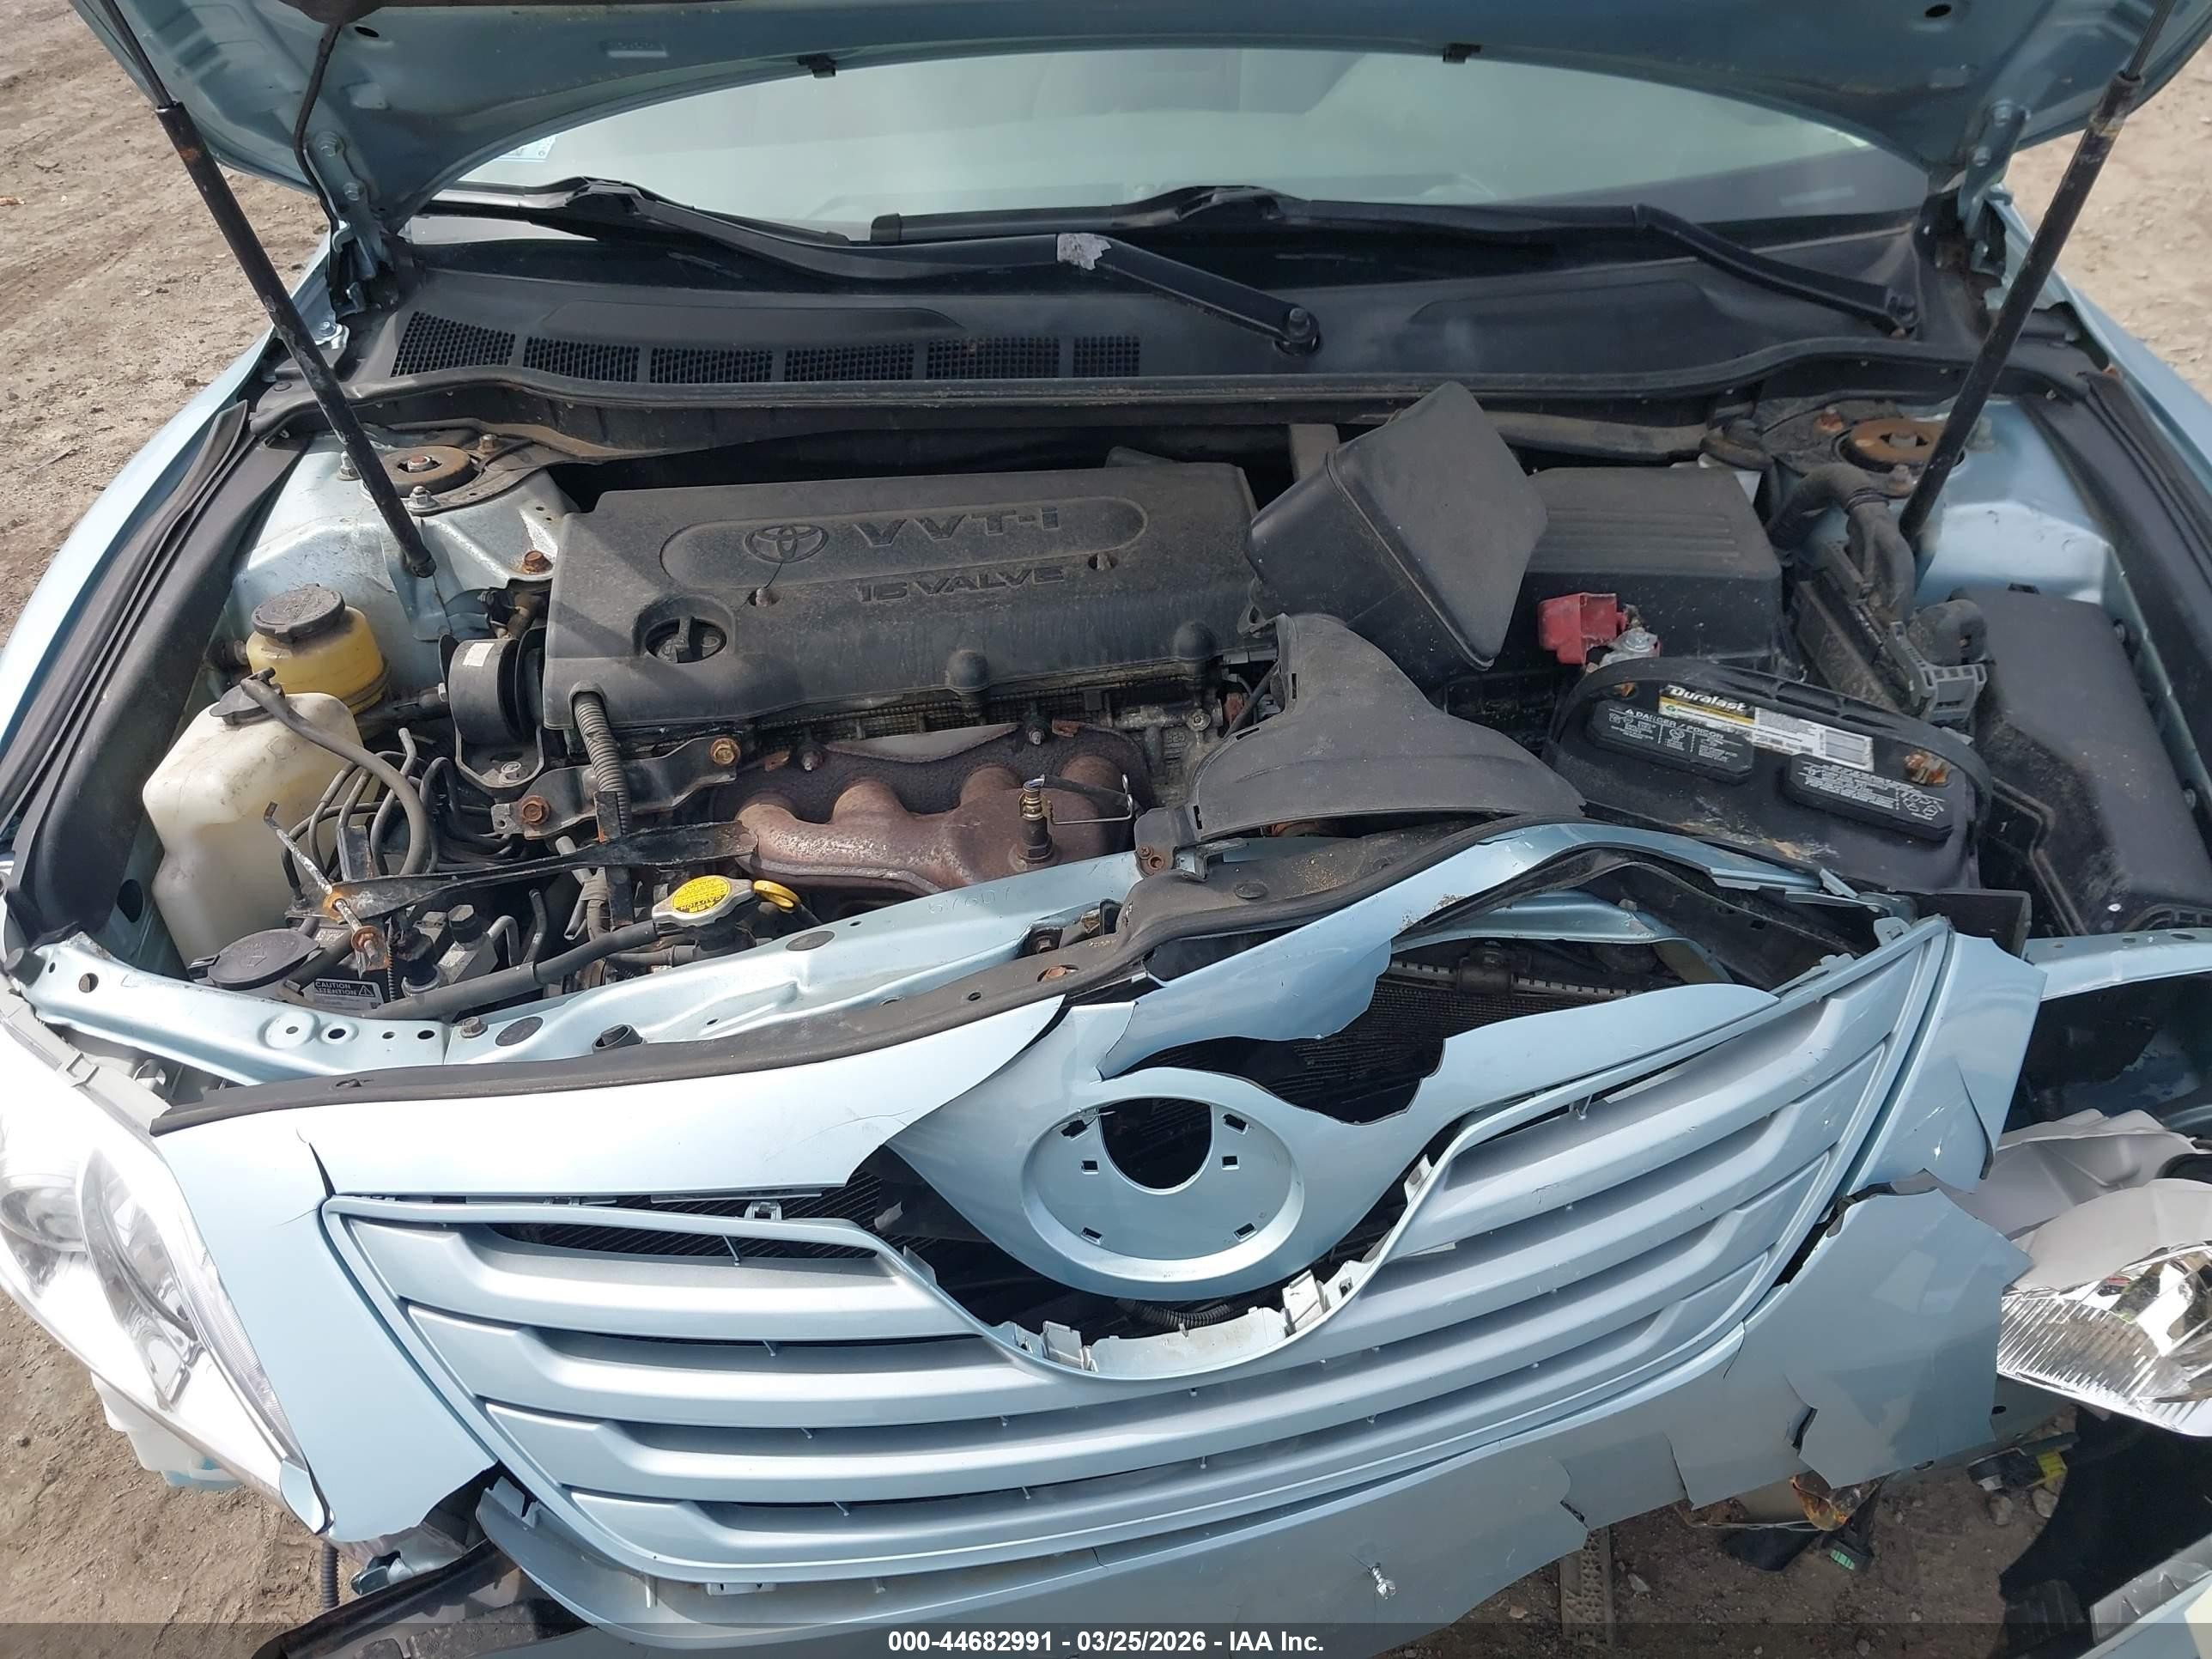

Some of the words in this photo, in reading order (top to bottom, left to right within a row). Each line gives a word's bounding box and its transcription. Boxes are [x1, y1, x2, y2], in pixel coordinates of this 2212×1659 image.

[856, 581, 908, 603] 16
[913, 566, 1065, 596] VALVE
[1668, 684, 1747, 712] Duralast
[1635, 711, 1677, 727] DANGER
[680, 896, 721, 911] CAUTION
